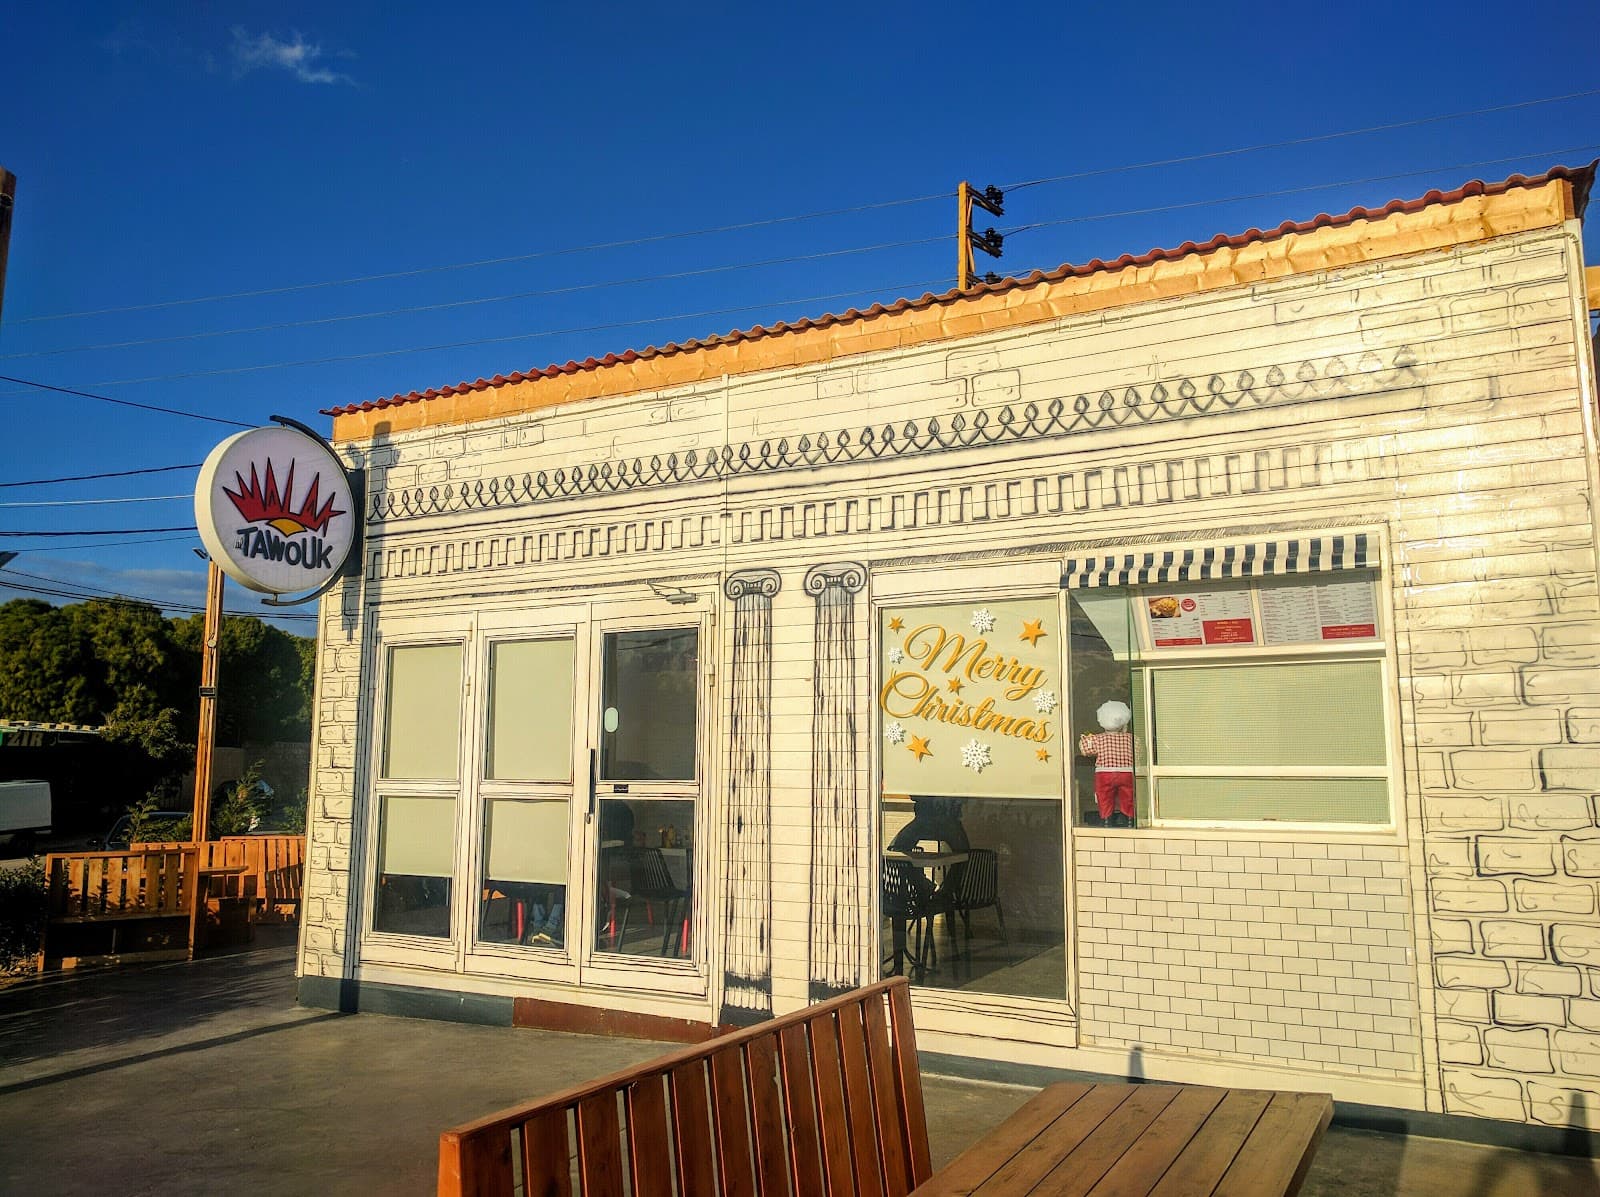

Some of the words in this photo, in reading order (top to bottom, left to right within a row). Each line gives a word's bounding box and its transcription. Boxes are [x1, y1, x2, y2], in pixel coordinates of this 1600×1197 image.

[236, 526, 333, 570] TAWOUK
[904, 624, 1049, 701] Merry
[880, 668, 1054, 743] Christmas
